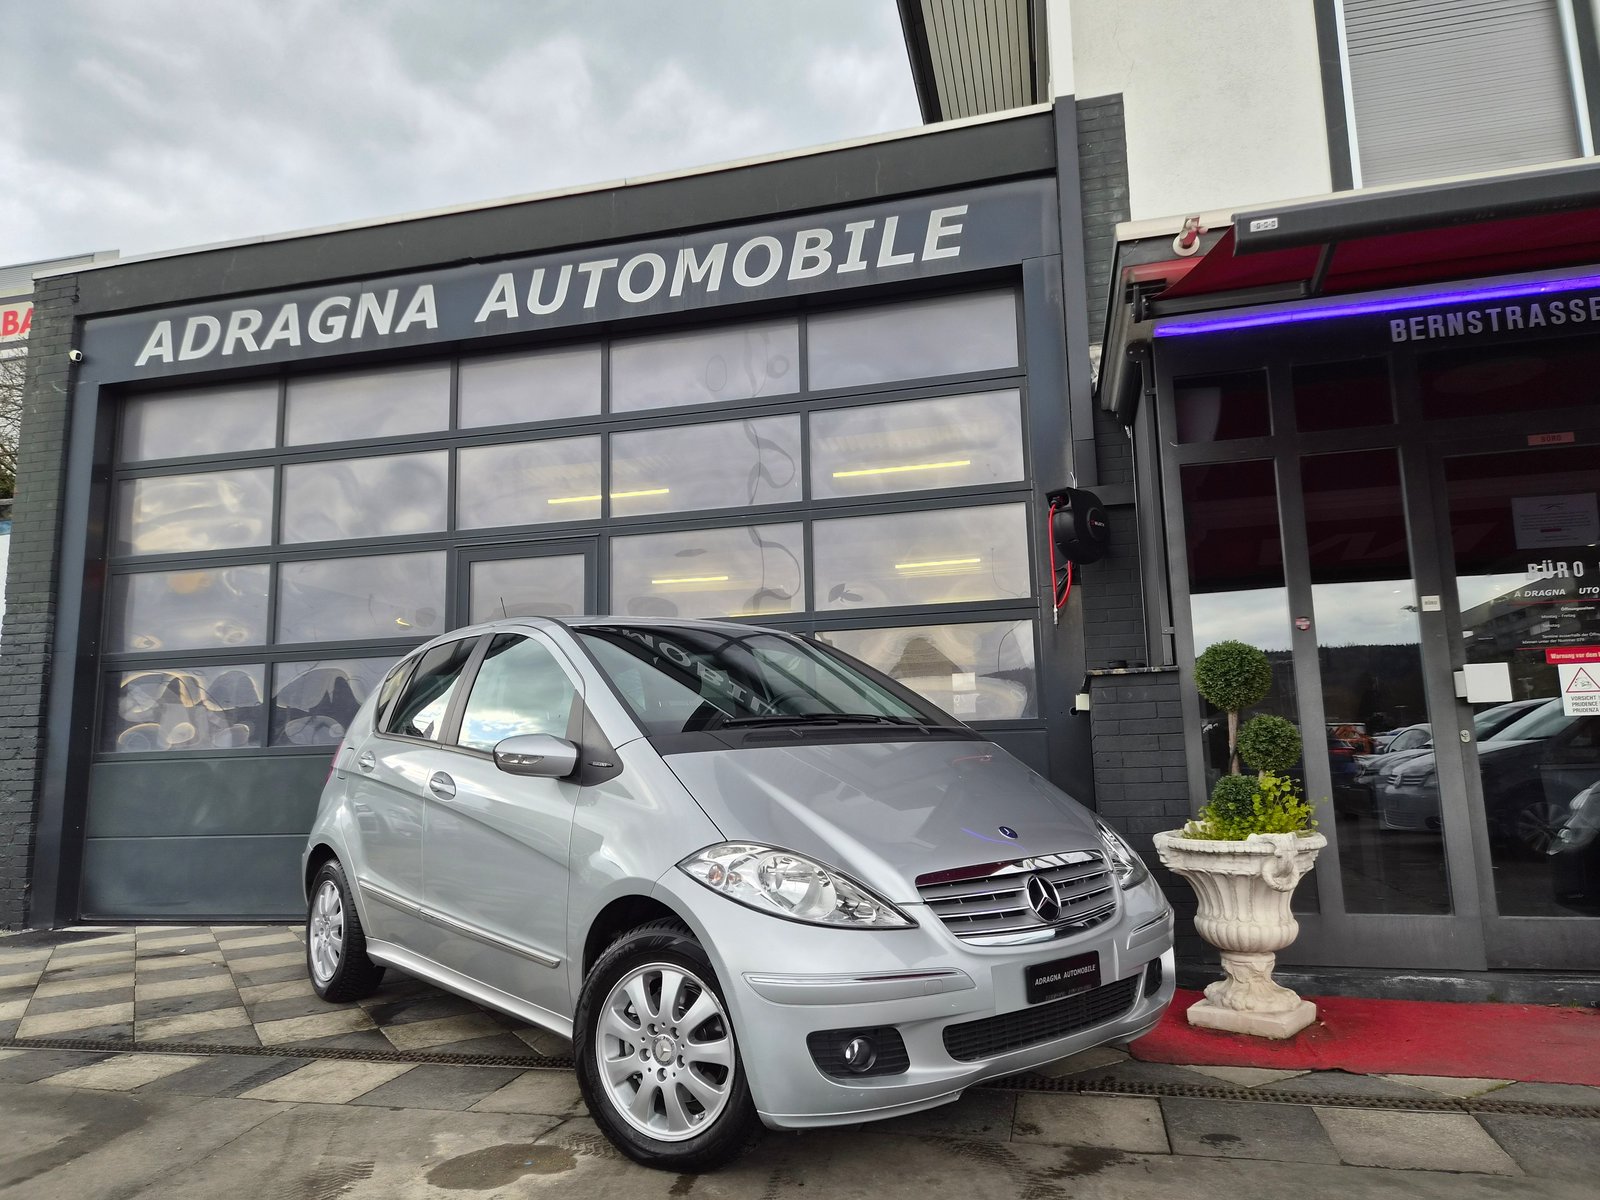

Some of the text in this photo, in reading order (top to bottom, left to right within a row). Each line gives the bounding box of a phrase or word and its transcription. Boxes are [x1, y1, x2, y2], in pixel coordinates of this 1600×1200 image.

[134, 204, 969, 367] ADRAGNA AUTOMOBILE
[1390, 296, 1600, 343] BERNSTRASSE
[1527, 559, 1584, 580] BÜRO
[1034, 964, 1096, 986] ADRAGNA AUTOMOBILE
